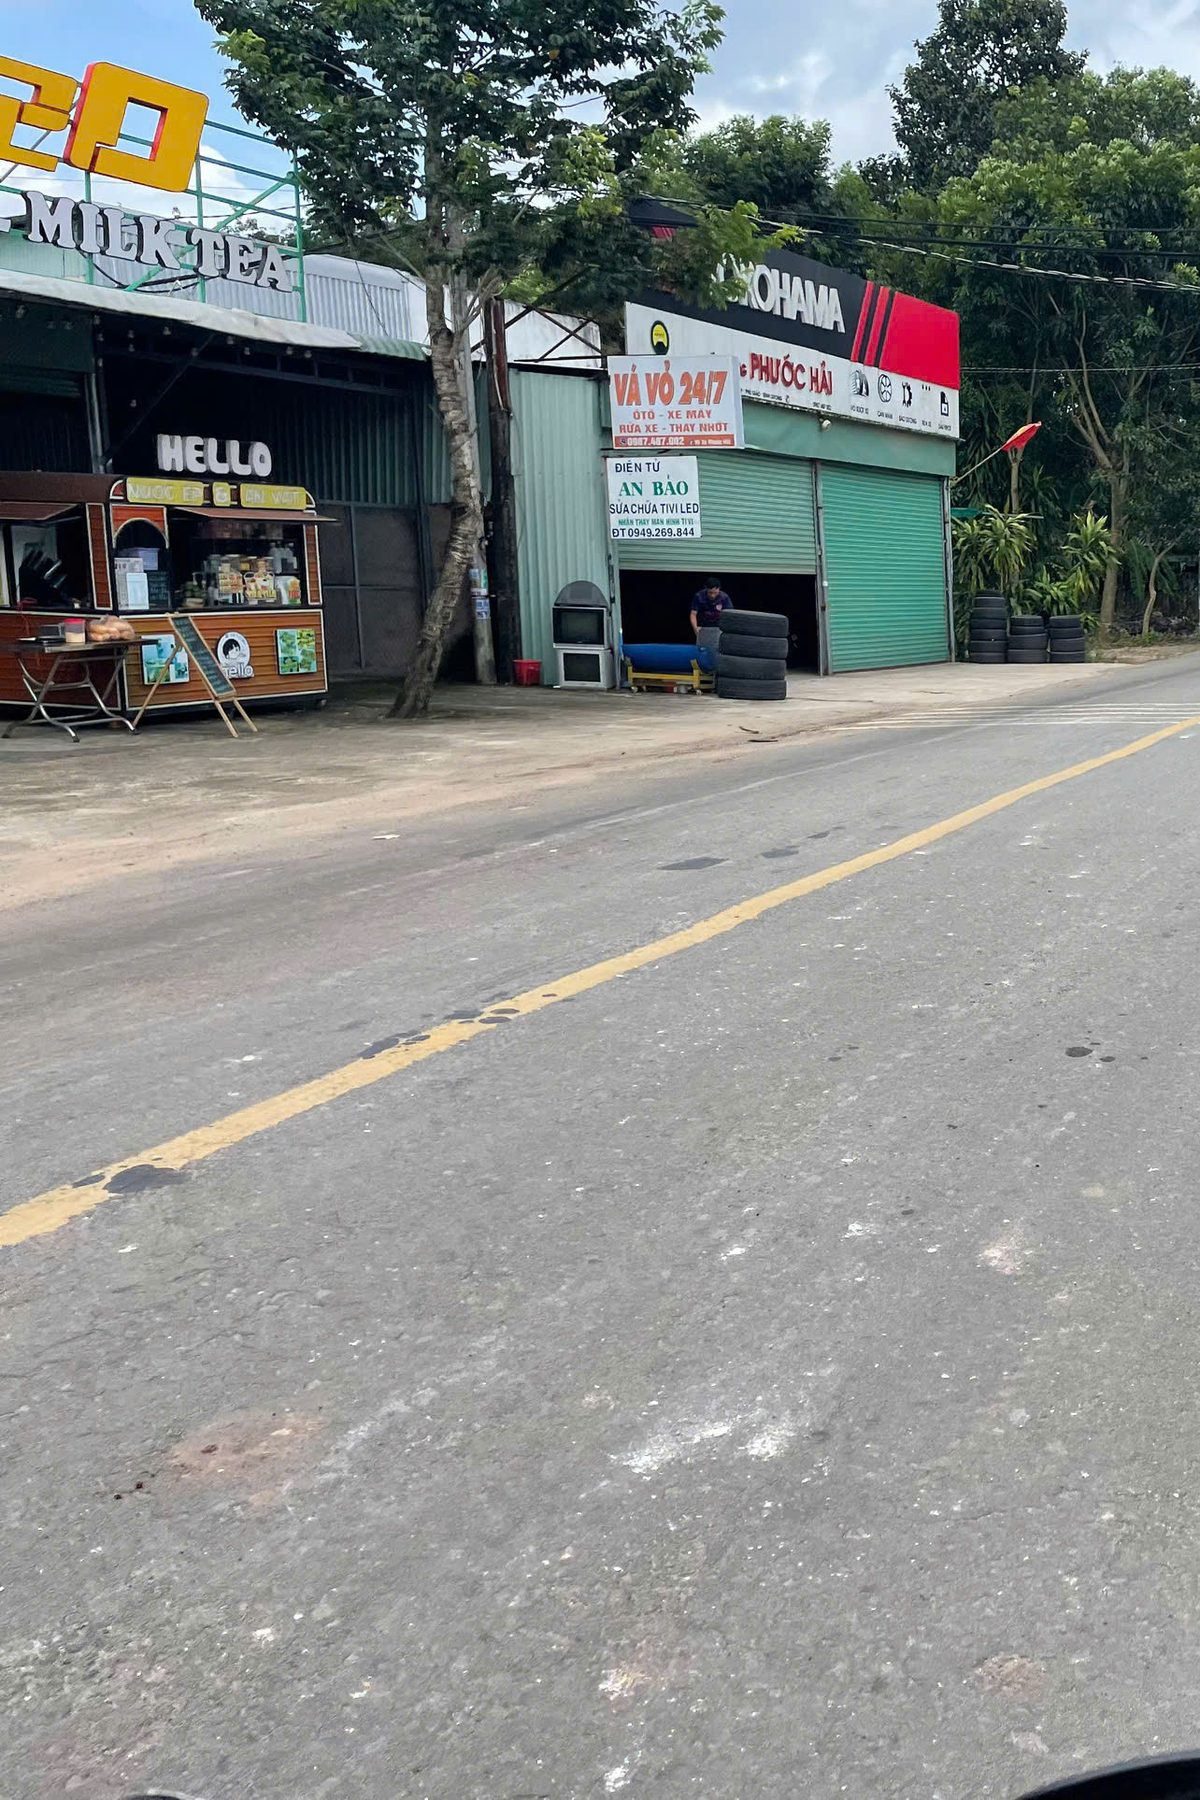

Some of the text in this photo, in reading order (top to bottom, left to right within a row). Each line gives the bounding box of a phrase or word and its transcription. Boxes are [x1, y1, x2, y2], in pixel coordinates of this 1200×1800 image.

[25, 190, 293, 292] MILK TEA
[711, 252, 846, 333] KOHAMA
[614, 360, 728, 406] VÁ VỎ 24/7
[750, 352, 806, 390] PHƯỚC
[667, 410, 681, 419] XE
[645, 424, 658, 433] XE
[669, 423, 695, 432] THAY
[157, 433, 272, 477] HELLO
[619, 481, 643, 496] AN
[660, 503, 678, 513] TIVI
[680, 502, 699, 513] LED
[612, 527, 694, 537] ĐT 0949.269.844
